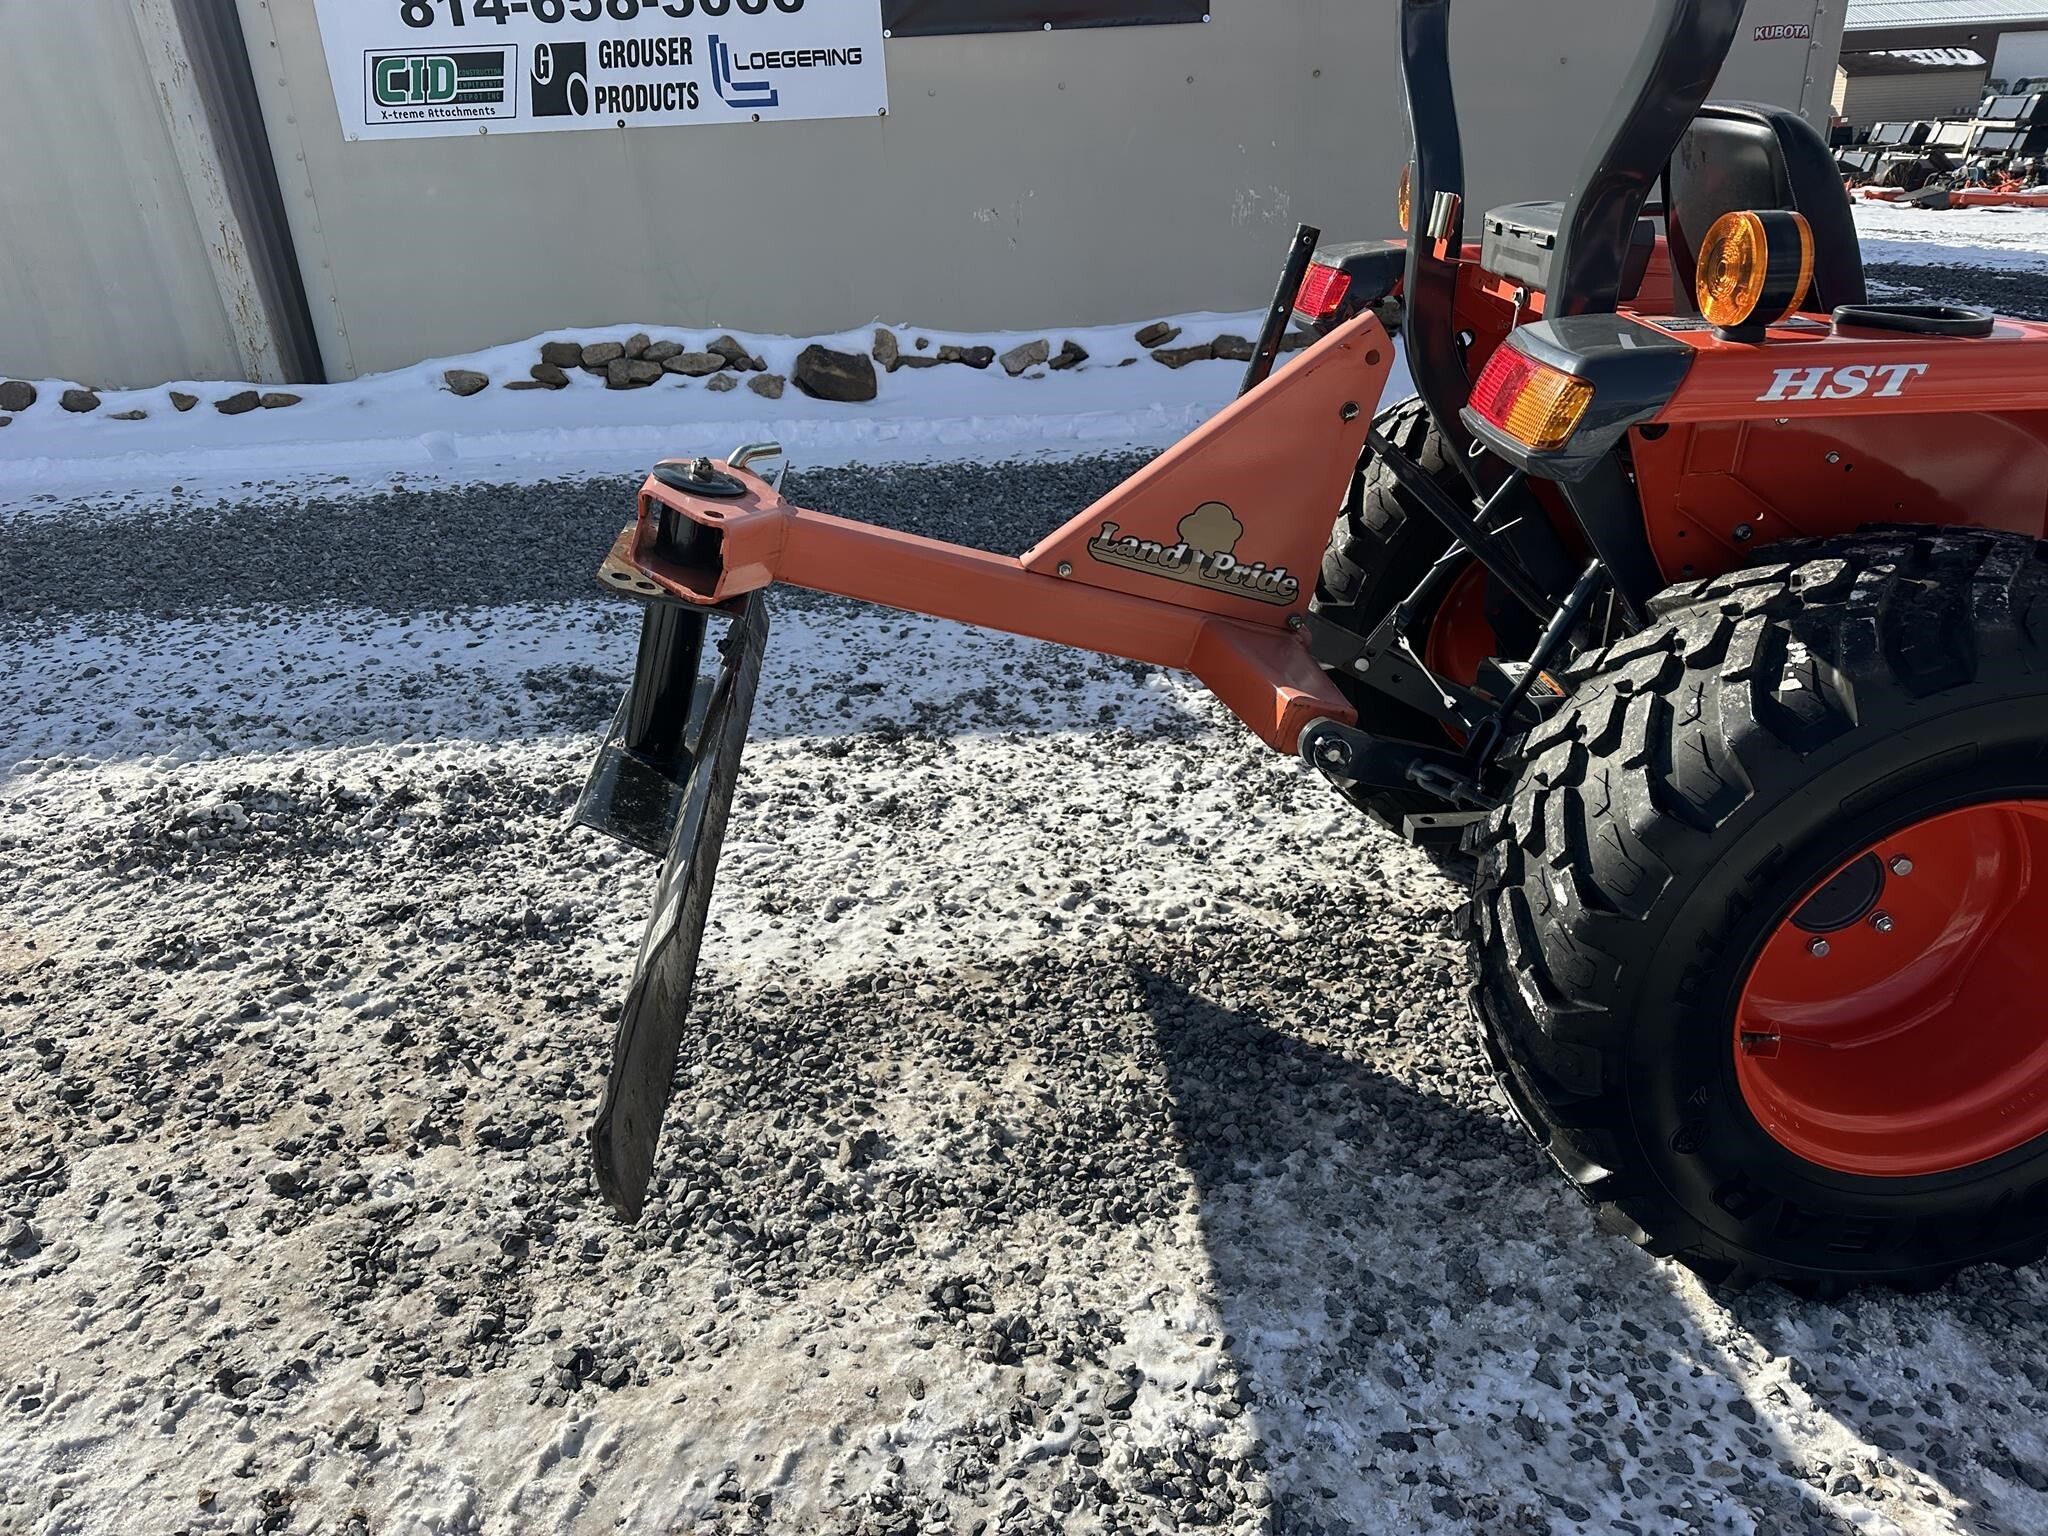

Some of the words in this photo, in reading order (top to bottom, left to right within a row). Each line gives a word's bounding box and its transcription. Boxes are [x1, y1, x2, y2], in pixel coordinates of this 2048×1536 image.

[1754, 24, 1809, 40] KUBOTA
[598, 36, 693, 69] GROUSER
[733, 47, 863, 71] LOEGERING
[376, 56, 457, 105] CID
[381, 110, 425, 120] X-treme
[428, 106, 496, 118] Attachments
[594, 81, 699, 114] PRODUCTS
[1756, 363, 1930, 402] HST
[1092, 521, 1190, 569] Land
[1203, 550, 1299, 597] Pride
